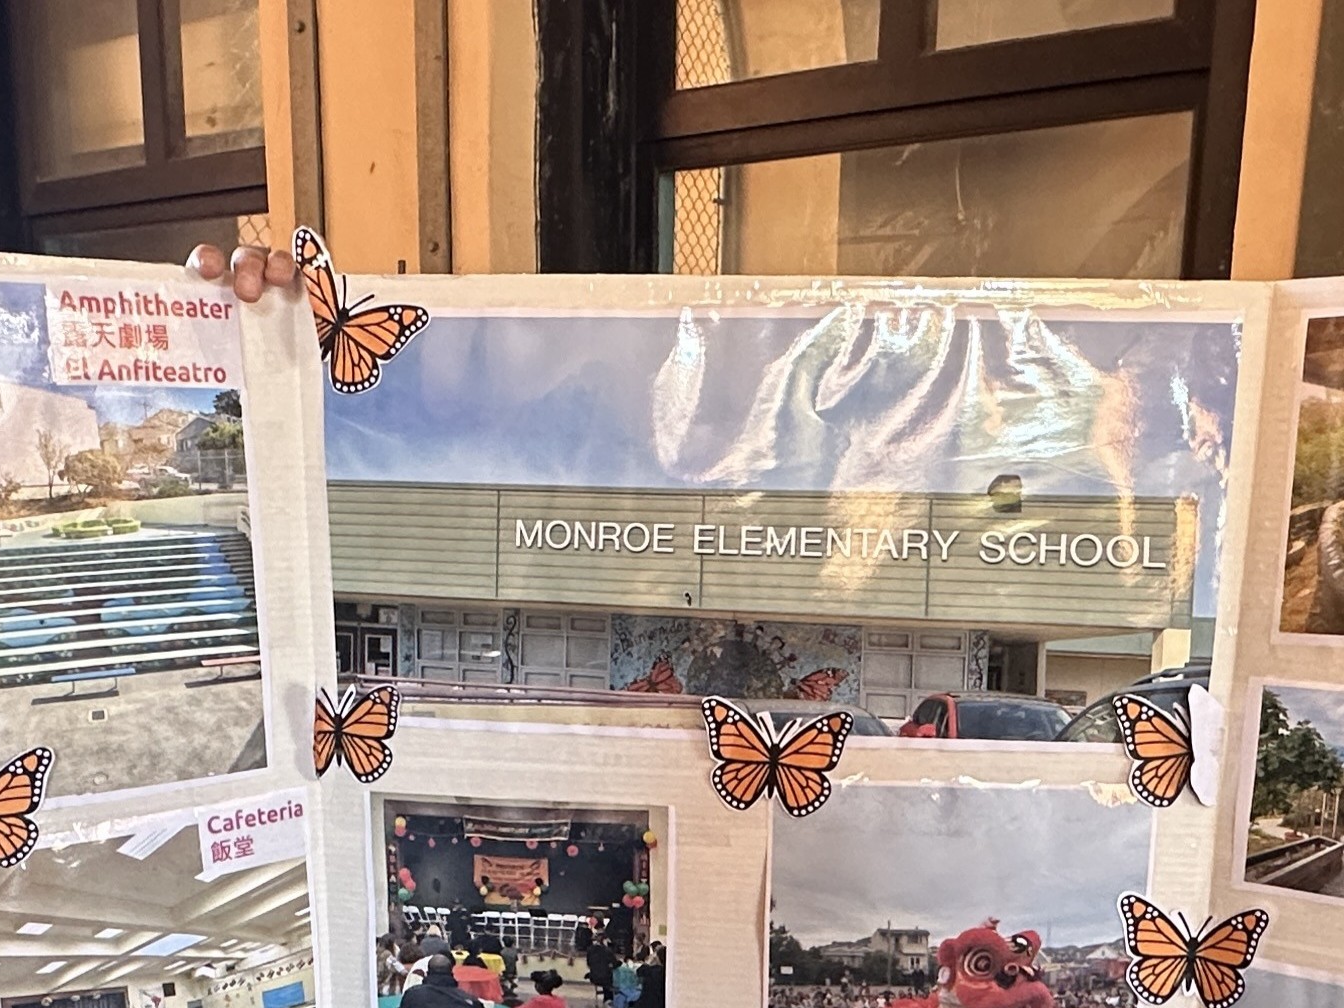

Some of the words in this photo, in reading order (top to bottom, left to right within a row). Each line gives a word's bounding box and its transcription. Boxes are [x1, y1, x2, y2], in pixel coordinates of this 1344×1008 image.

[59, 290, 233, 319] Amphitheater
[66, 357, 91, 380] El
[98, 358, 227, 383] Anfiteatro
[515, 518, 675, 554] MONROE
[693, 523, 960, 562] ELEMENTARY
[979, 532, 1167, 570] SCHOOL
[207, 800, 304, 834] Cafeteria
[210, 836, 255, 863] 飯堂
